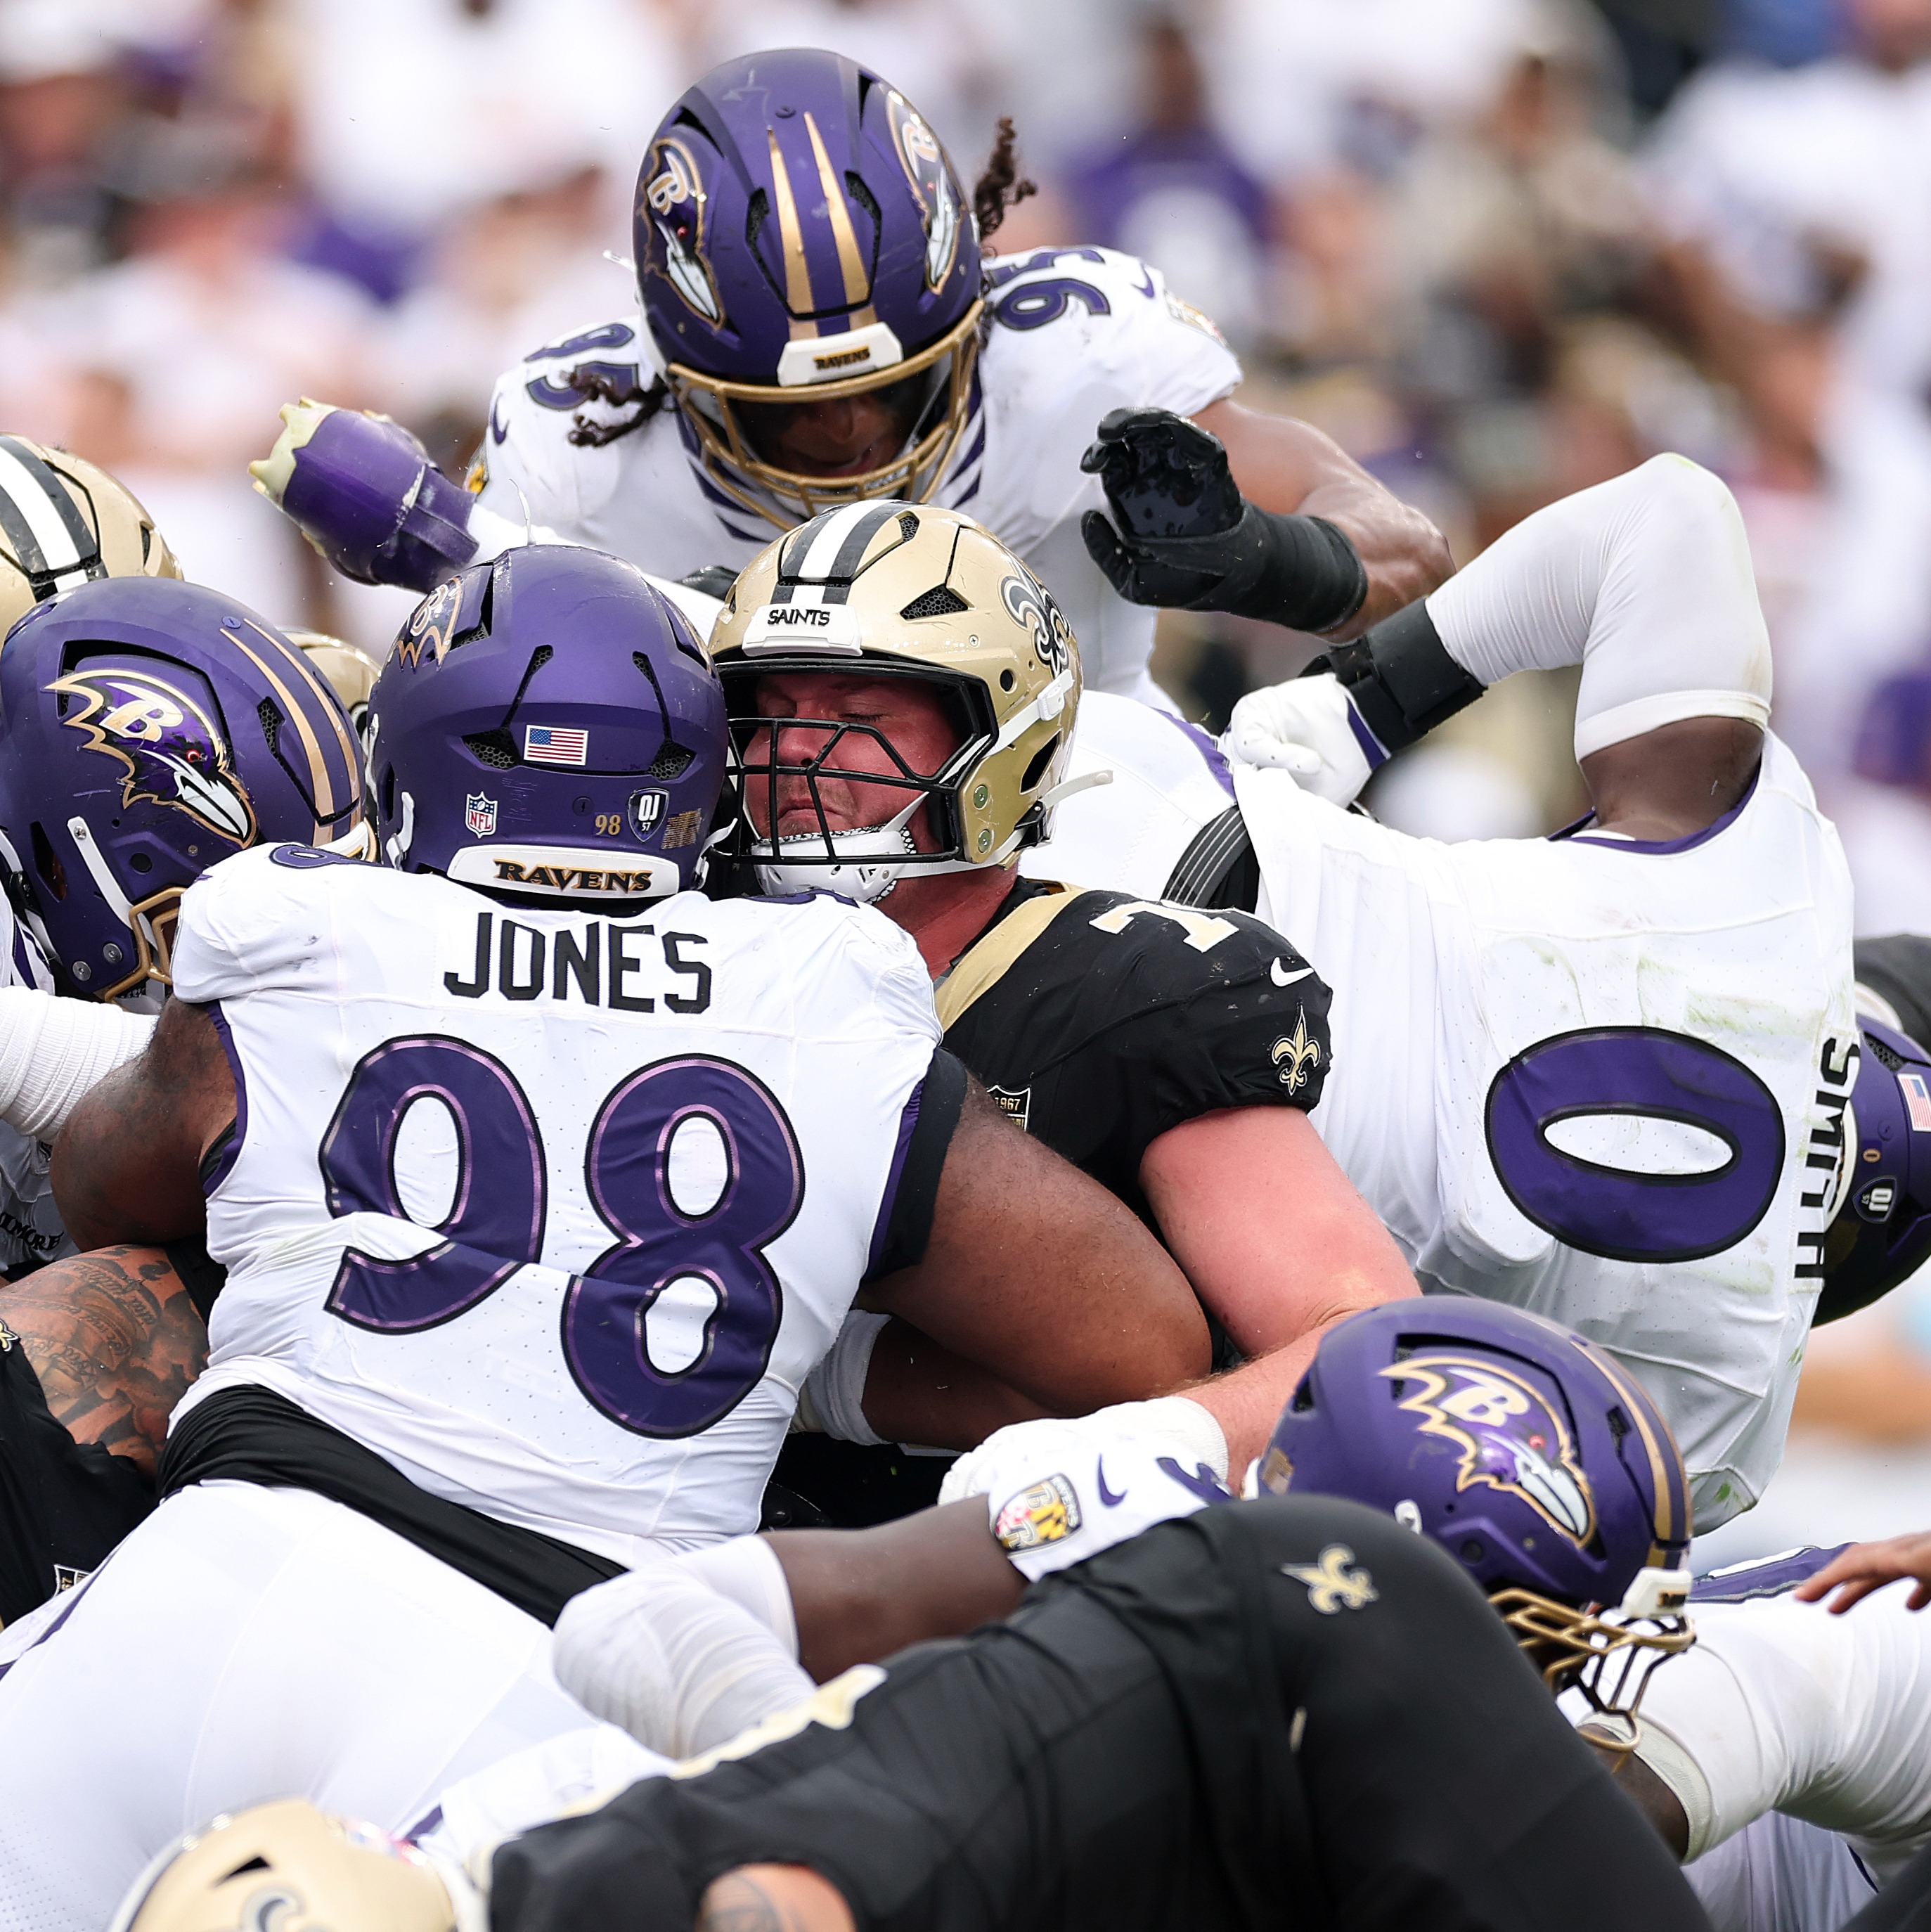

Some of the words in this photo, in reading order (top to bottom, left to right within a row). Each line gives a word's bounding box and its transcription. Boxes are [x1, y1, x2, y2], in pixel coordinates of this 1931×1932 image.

[813, 345, 871, 370] RAVENS
[767, 608, 831, 626] SAINTS
[470, 810, 491, 830] NFL
[594, 813, 621, 836] 98
[641, 822, 652, 832] 57
[493, 858, 654, 896] RAVENS
[444, 912, 712, 1014] JONES
[1484, 1024, 1786, 1264] 0
[0, 1212, 65, 1251] IMORE
[318, 1033, 806, 1441] 98
